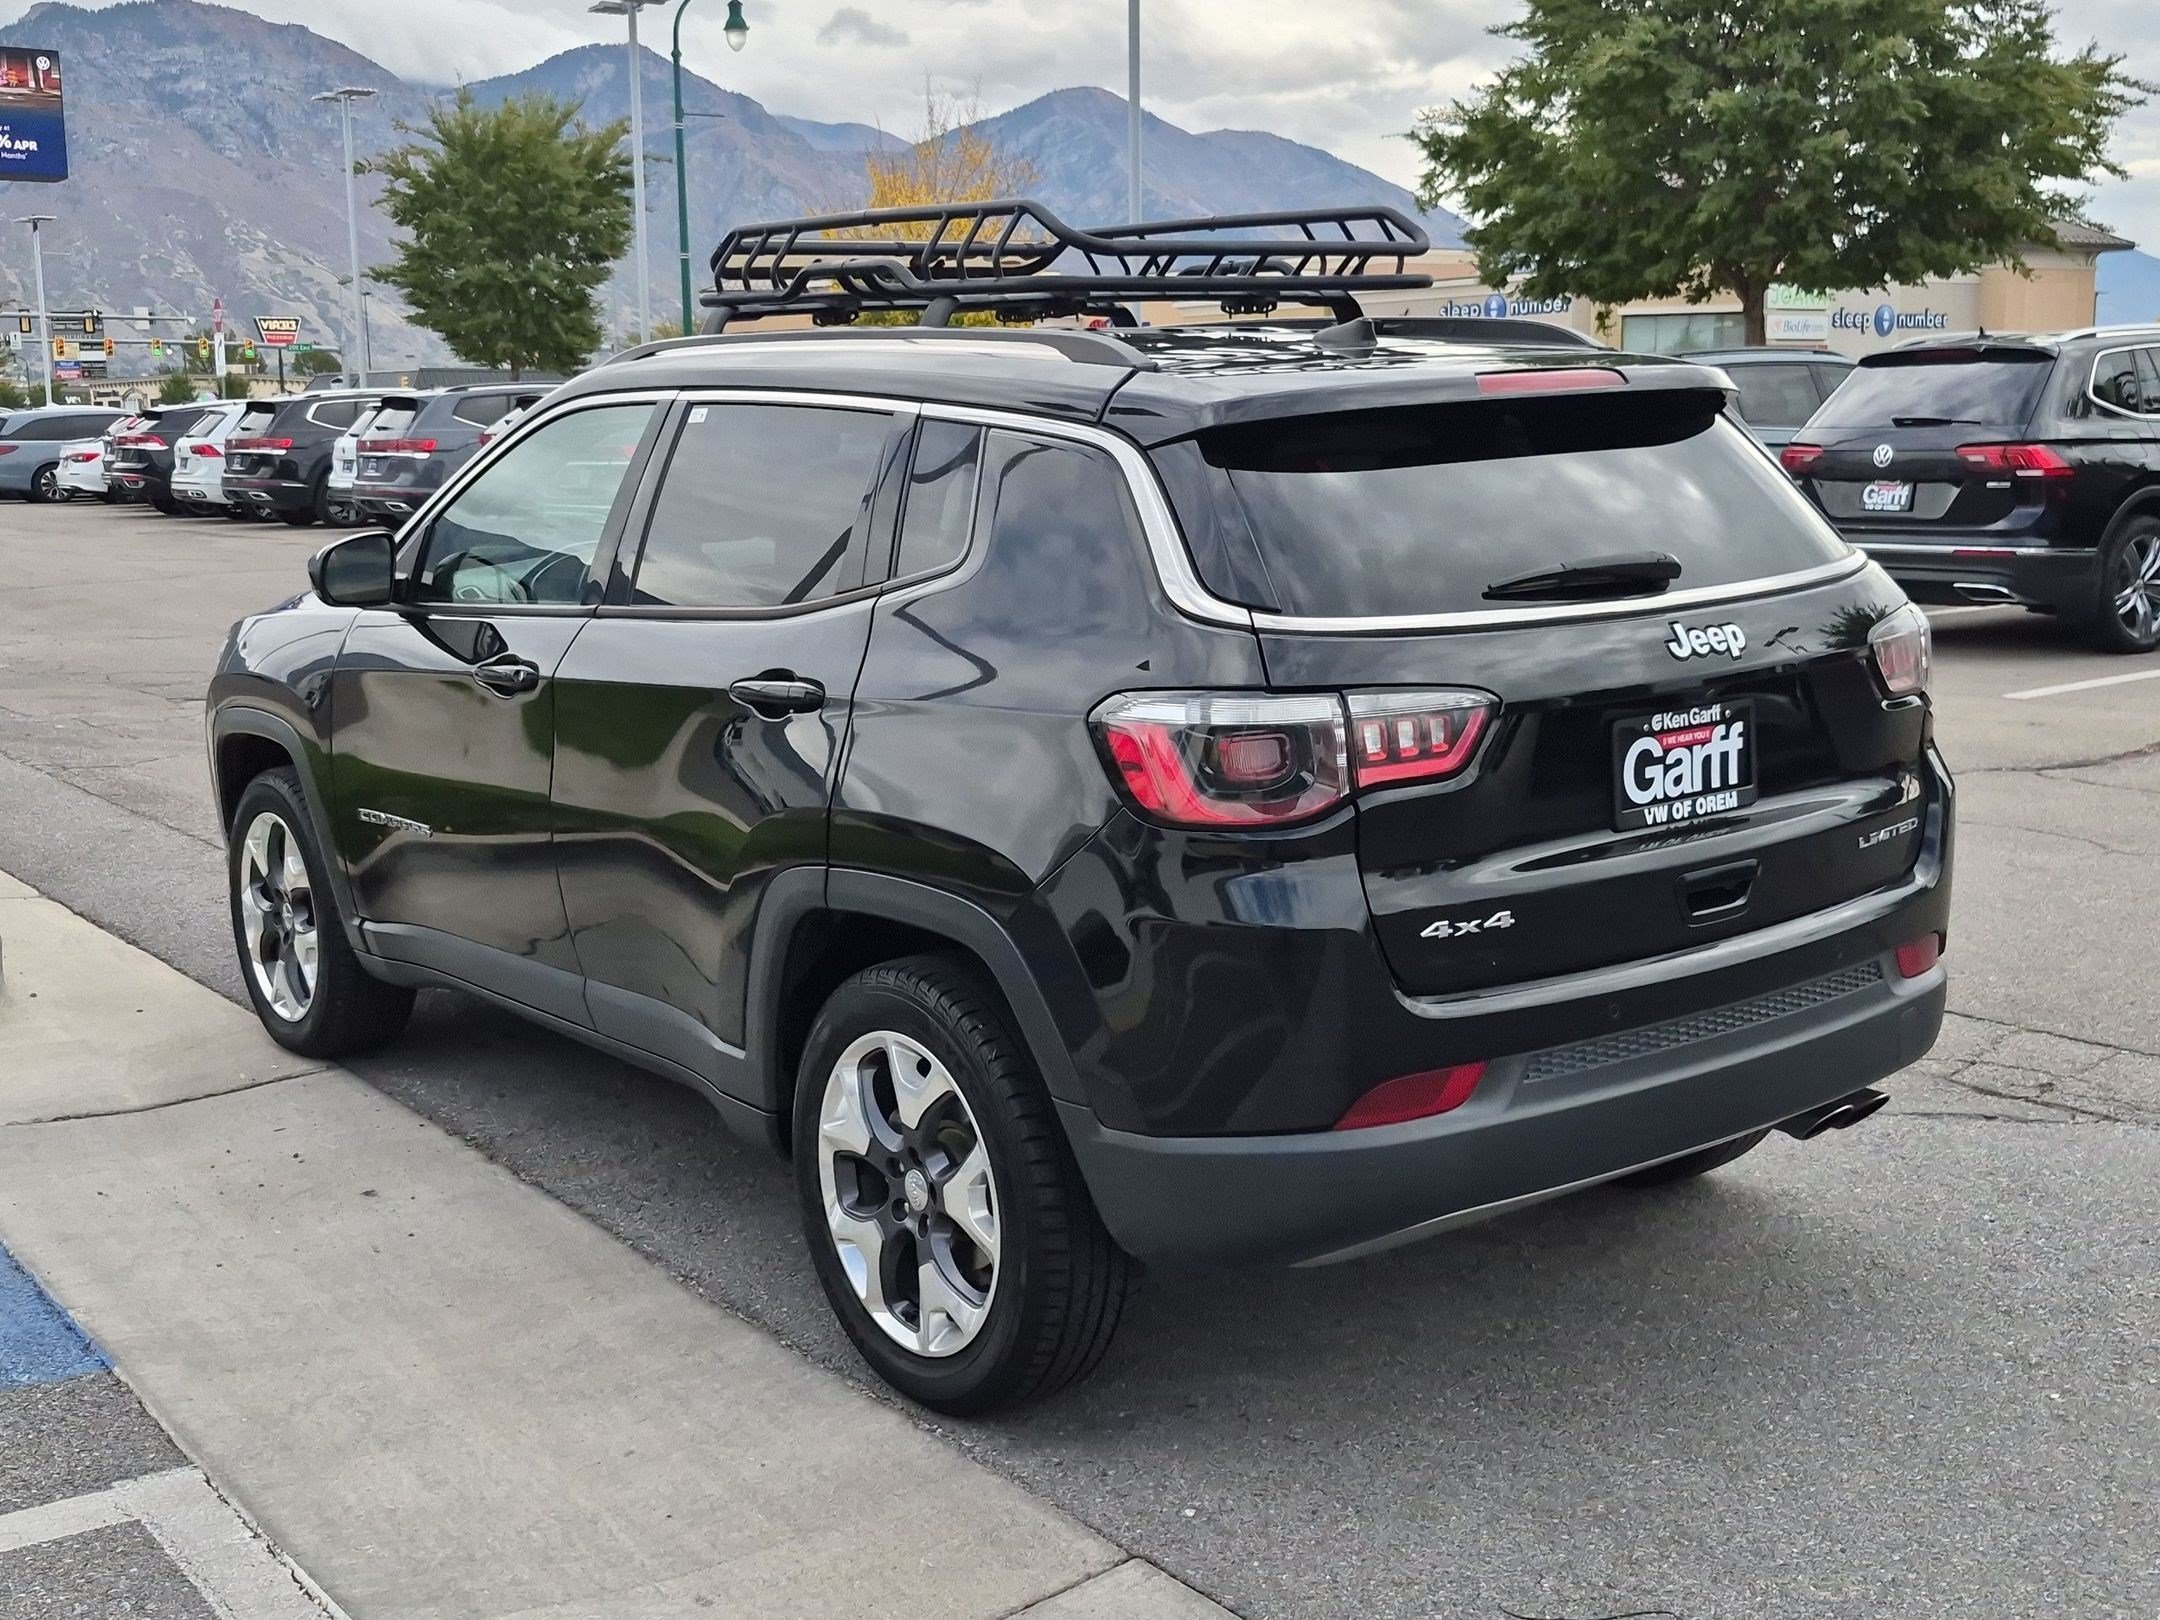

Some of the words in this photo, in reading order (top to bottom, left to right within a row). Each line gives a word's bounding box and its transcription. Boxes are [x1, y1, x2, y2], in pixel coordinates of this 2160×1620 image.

[13, 139, 38, 151] APR
[260, 320, 297, 331] VIA313
[1832, 307, 1871, 335] sleep
[1896, 308, 1949, 329] number
[1863, 483, 1909, 506] Garff
[1665, 621, 1746, 660] Jeep
[1663, 712, 1690, 730] Ken
[1689, 704, 1721, 726] Garff
[1677, 732, 1694, 744] HEAR
[1693, 731, 1706, 742] YOU
[1623, 721, 1744, 805] Garff
[1643, 805, 1668, 826] VW
[1671, 800, 1692, 820] OF
[1695, 791, 1738, 815] OREM
[1420, 910, 1516, 939] 4x4
